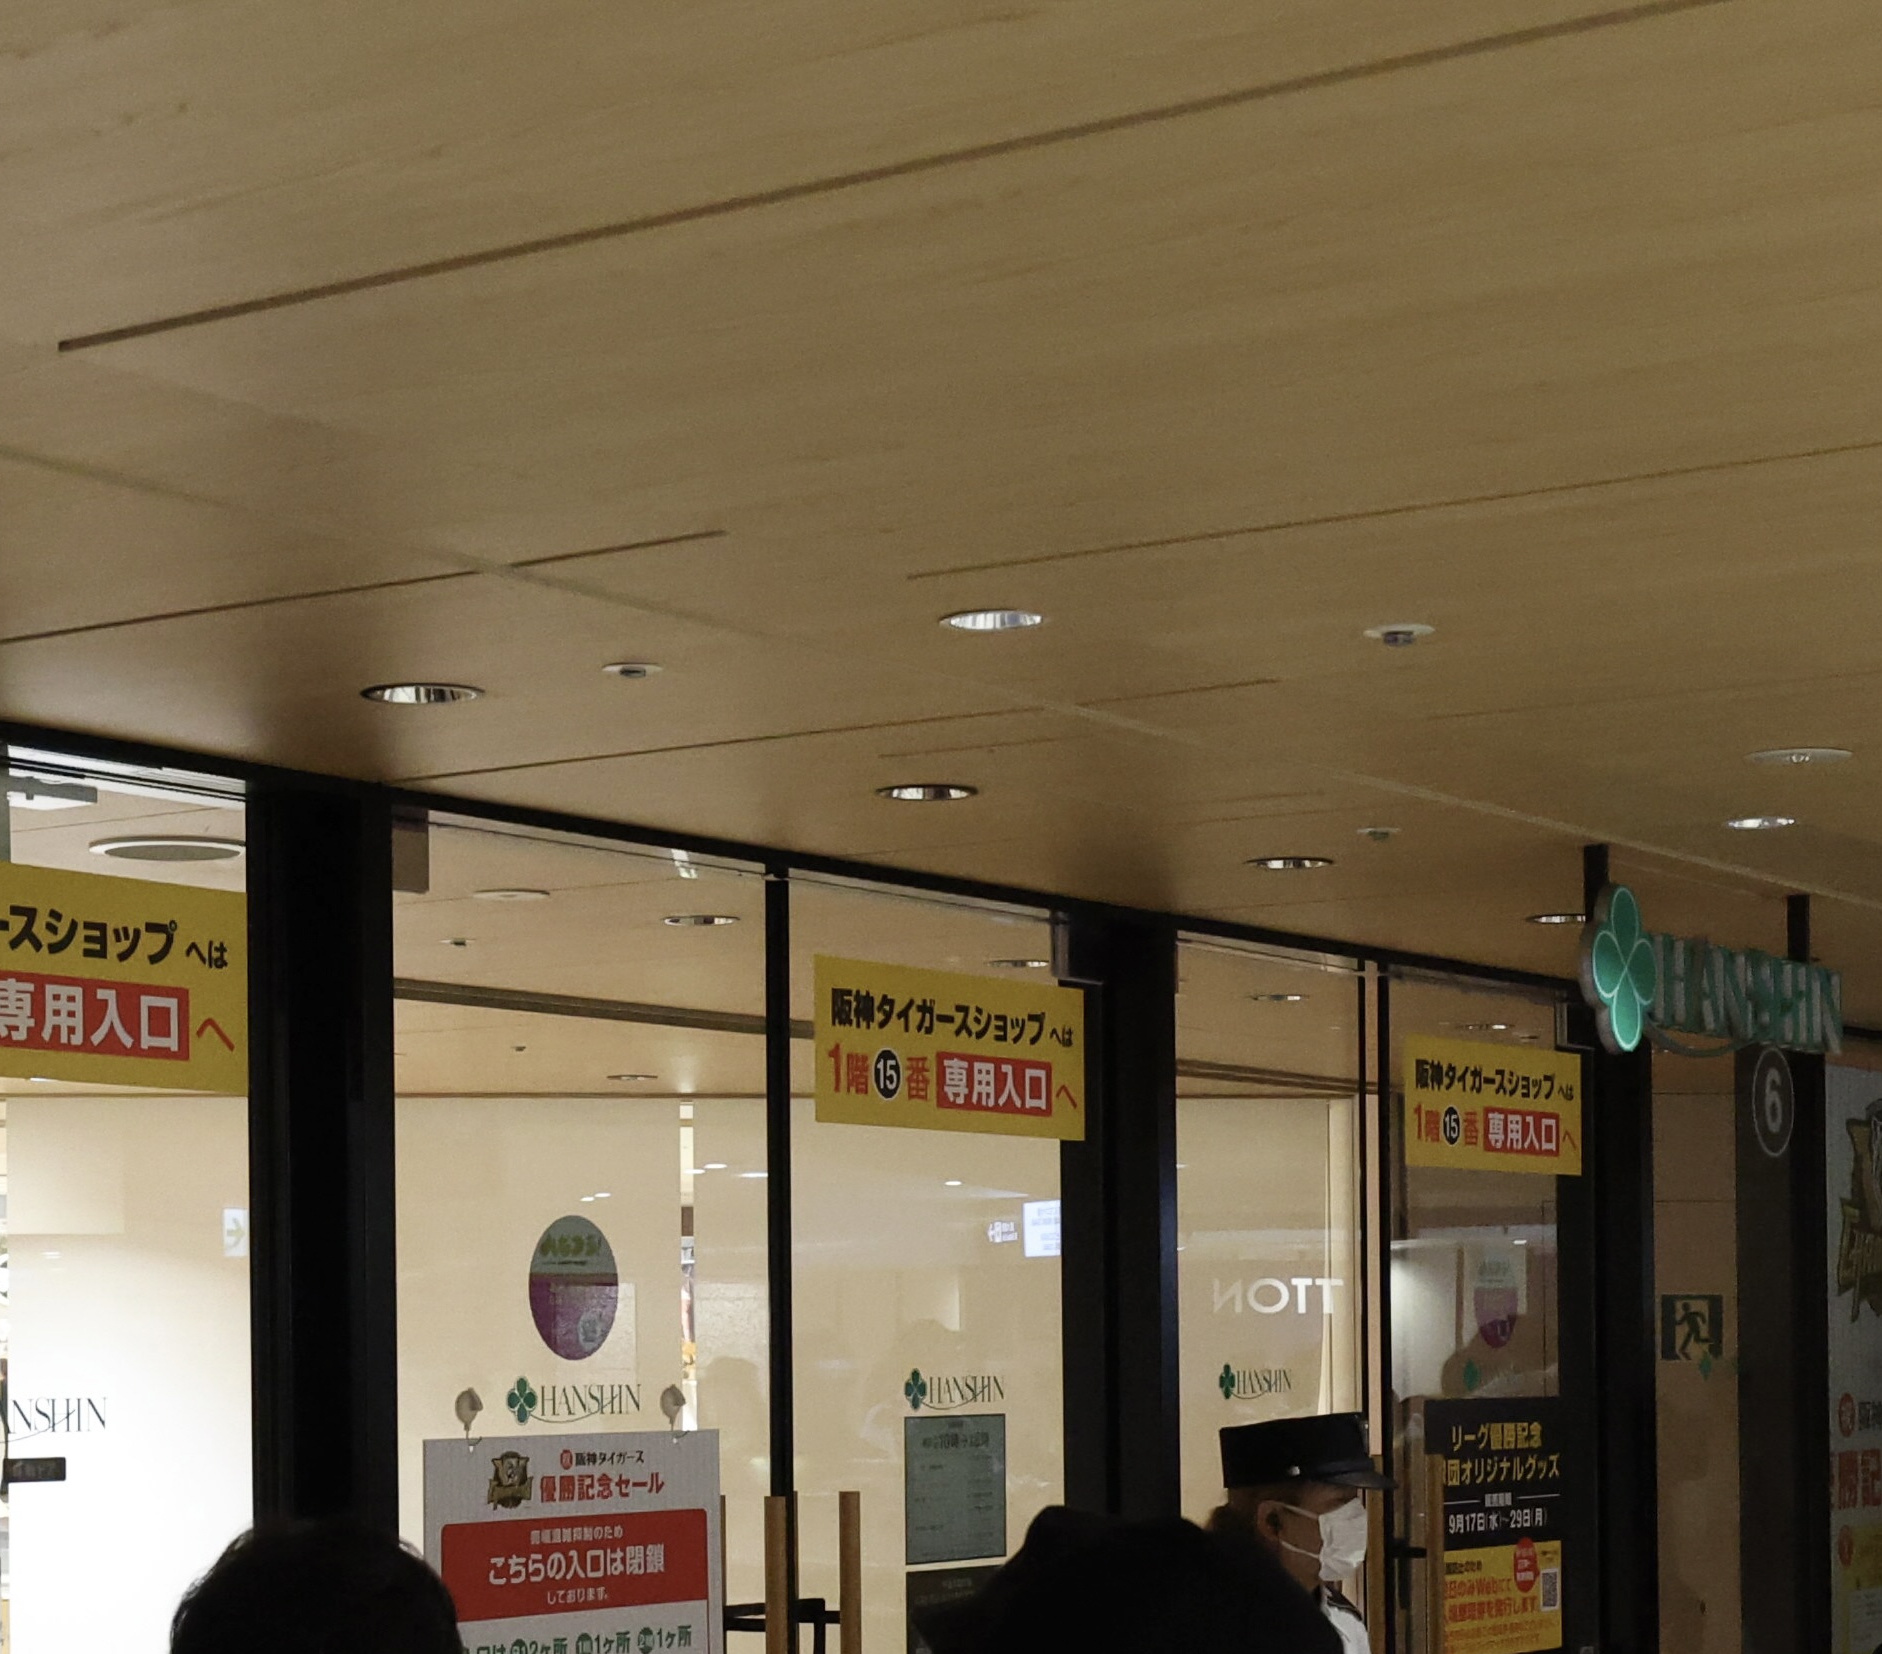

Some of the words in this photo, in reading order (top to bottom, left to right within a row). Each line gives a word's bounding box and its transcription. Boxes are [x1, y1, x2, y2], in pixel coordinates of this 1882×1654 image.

[831, 987, 1074, 1047] 阪神タイガースショップへは
[1765, 1067, 1783, 1134] 6
[928, 1375, 1005, 1404] HANSHIN
[1236, 1368, 1292, 1395] HANSHIN
[541, 1383, 641, 1417] HANSHIN
[1443, 1452, 1561, 1487] 団オリジナルグッズ
[540, 1471, 665, 1503] 優勝記念セール
[488, 1542, 665, 1586] こちらの入口は閉鎖
